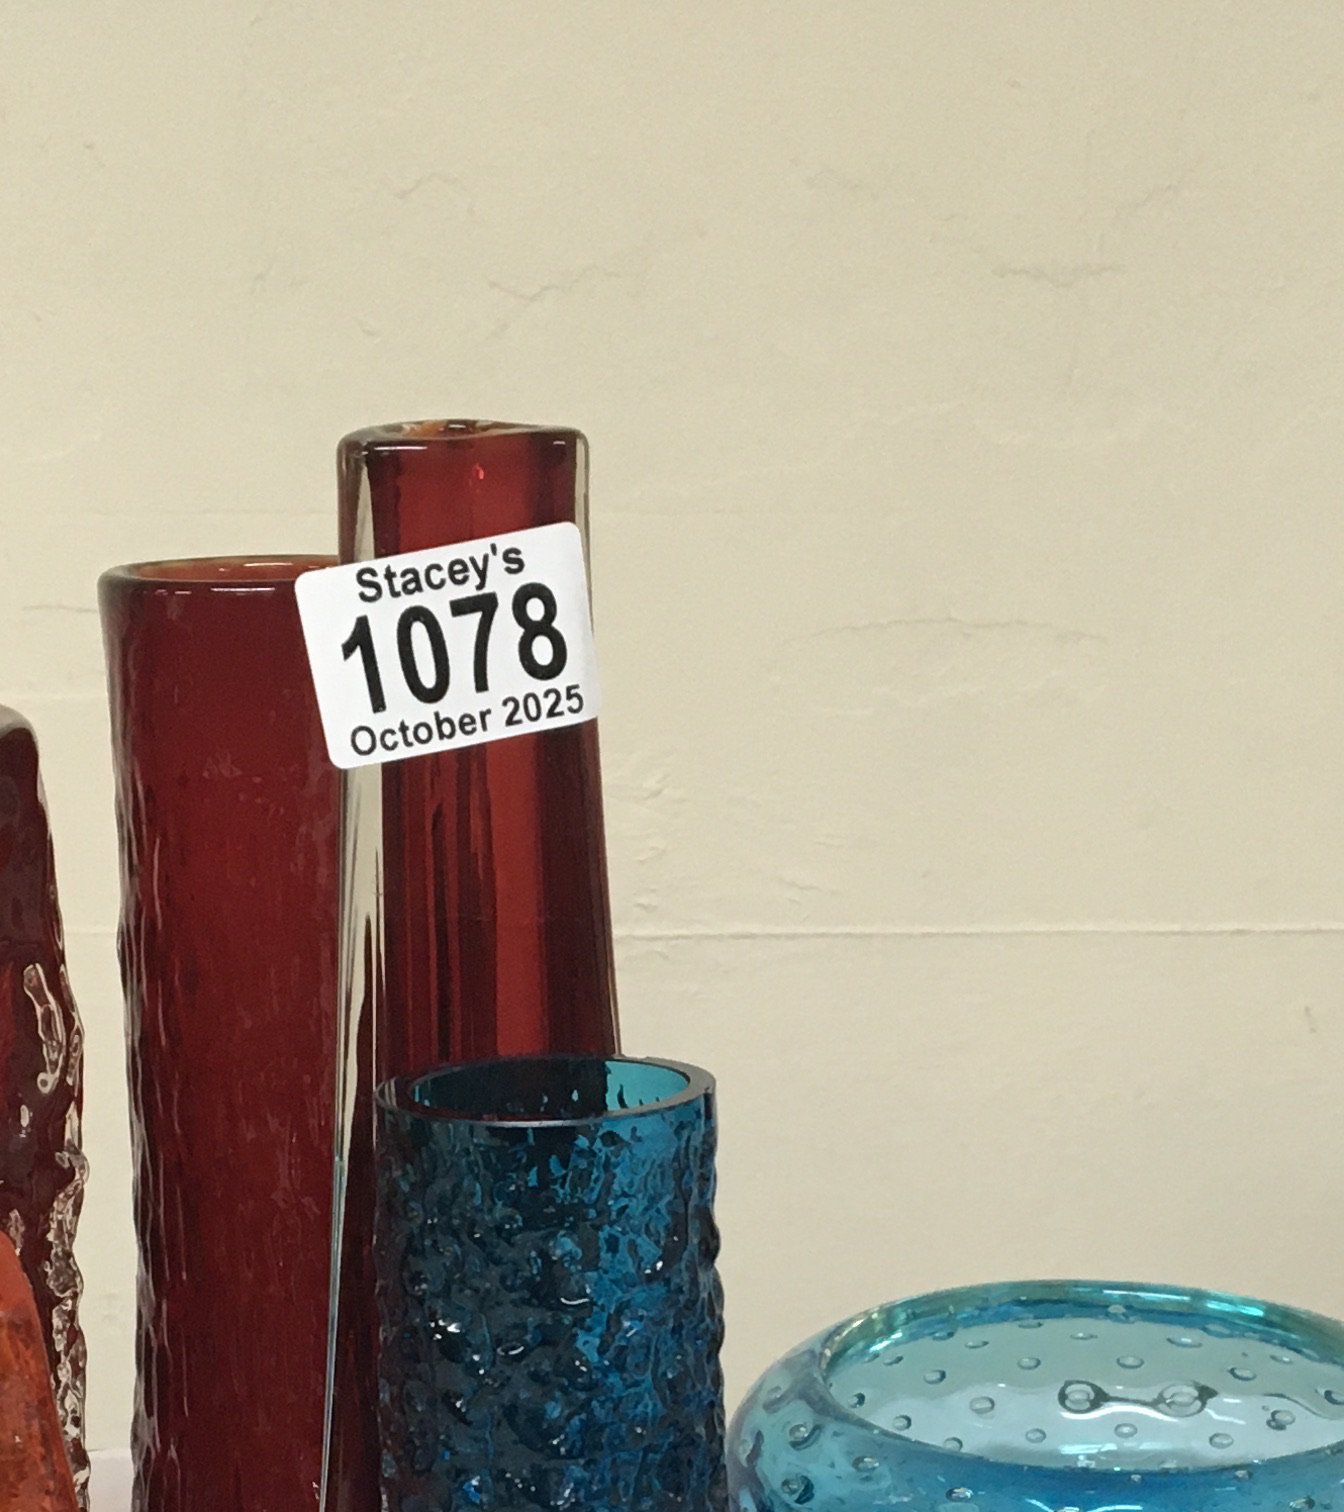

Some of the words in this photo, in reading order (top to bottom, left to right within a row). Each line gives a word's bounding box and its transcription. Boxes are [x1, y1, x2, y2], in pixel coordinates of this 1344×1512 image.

[355, 543, 526, 603] Stacey's
[341, 582, 568, 715] 1078
[350, 709, 493, 756] October
[501, 684, 585, 727] 2025
